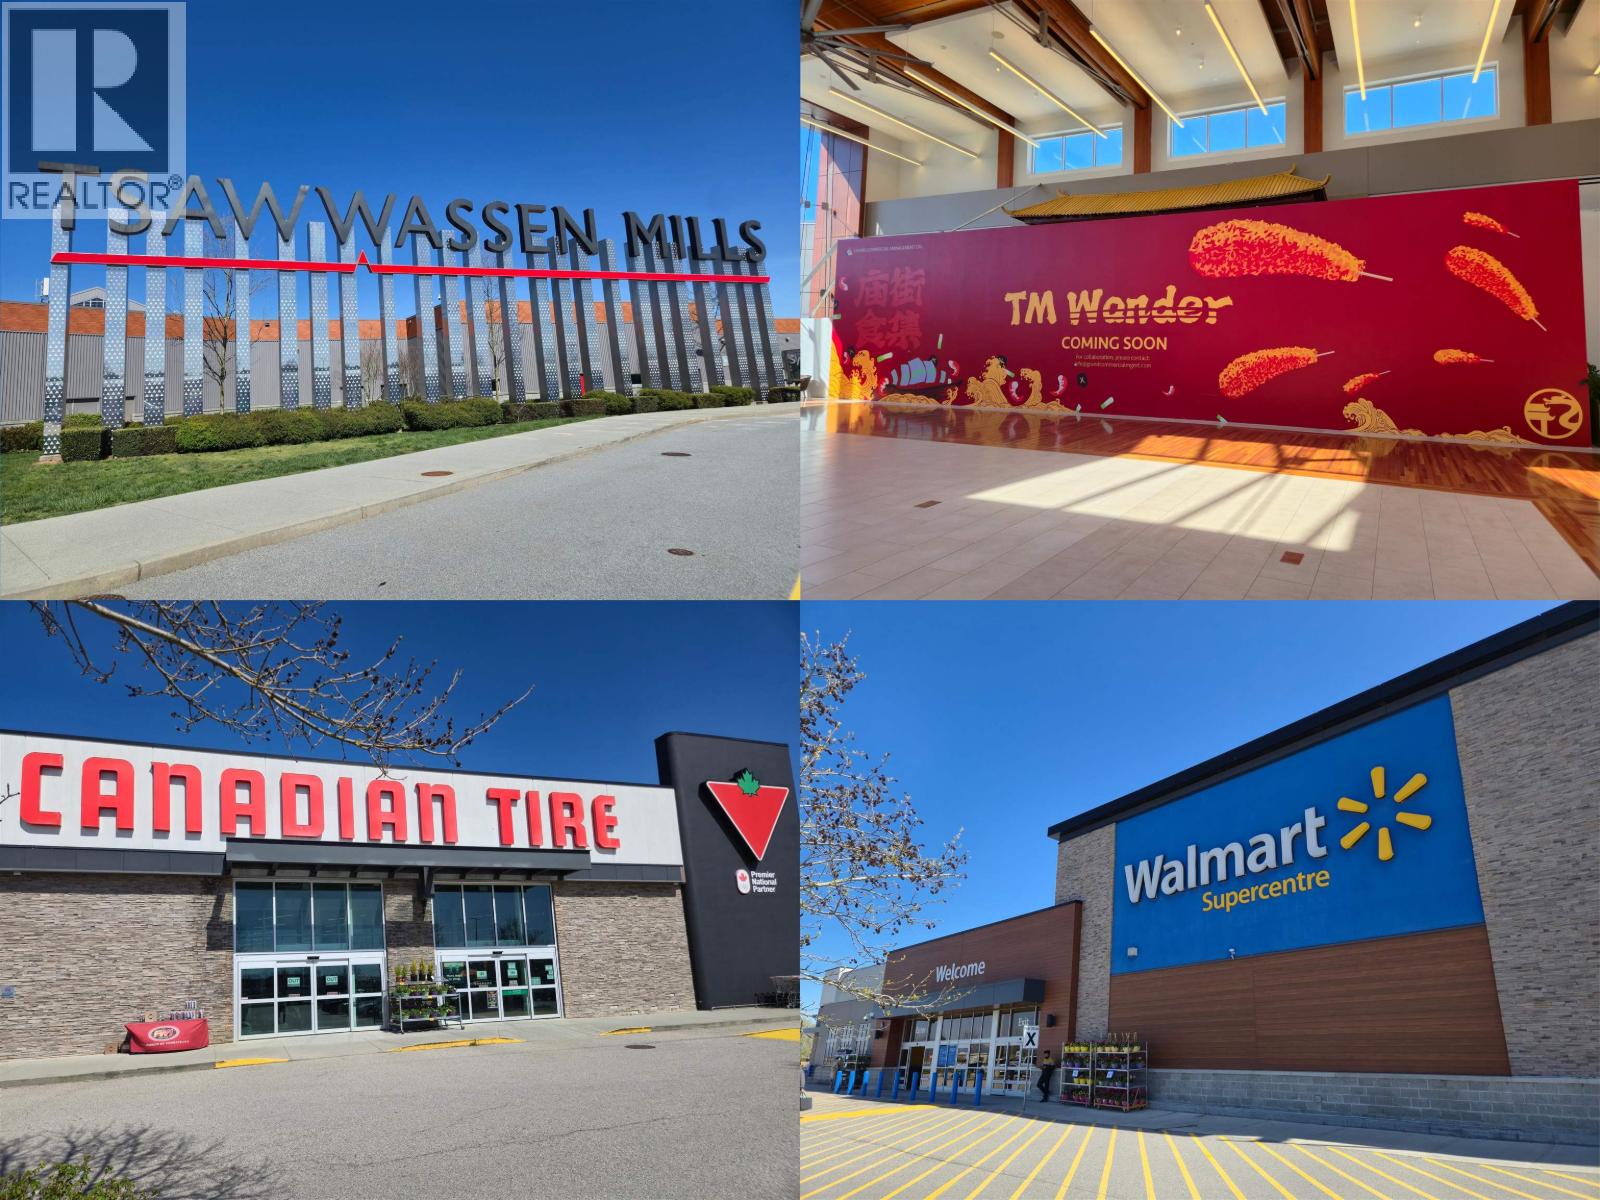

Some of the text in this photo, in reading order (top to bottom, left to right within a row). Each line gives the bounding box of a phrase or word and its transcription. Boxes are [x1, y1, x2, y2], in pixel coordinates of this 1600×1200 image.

[38, 160, 768, 264] TSAWWASSEN MILLS
[1004, 289, 1057, 326] TM
[1061, 336, 1168, 350] COMING SOON
[20, 751, 622, 849] CANADIAN TIRE
[1124, 806, 1329, 904] Walmart
[1202, 869, 1331, 913] Supercentre
[935, 960, 986, 983] Welcome
